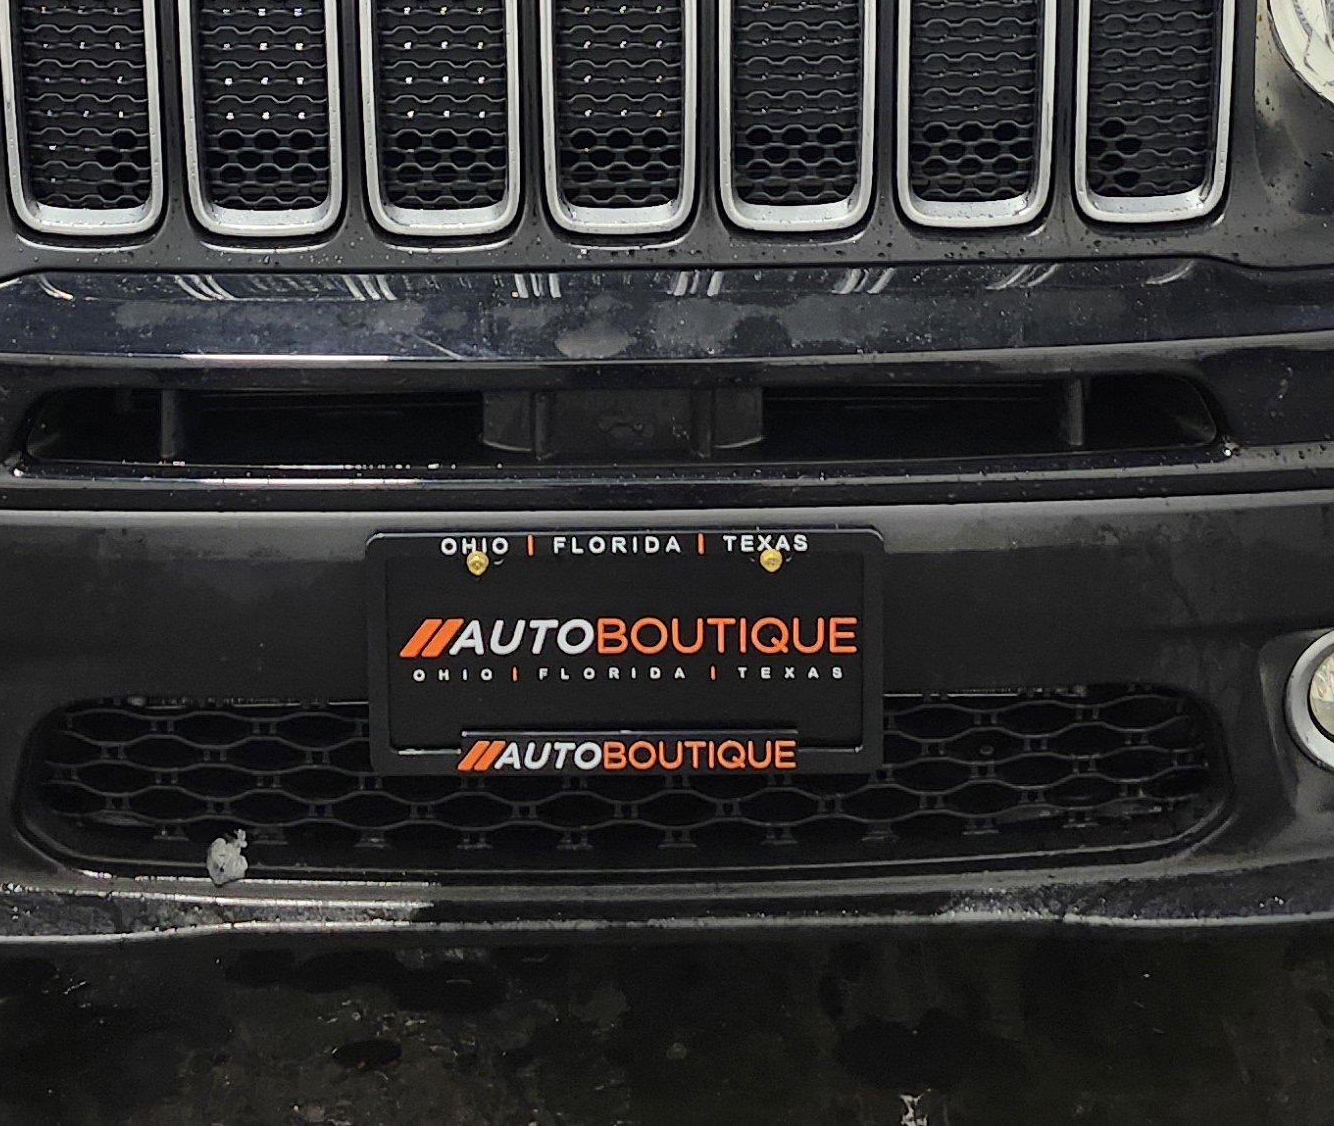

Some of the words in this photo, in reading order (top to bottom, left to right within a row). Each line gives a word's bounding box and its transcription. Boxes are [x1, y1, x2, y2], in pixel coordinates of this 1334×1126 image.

[441, 537, 509, 555] OHIO
[553, 535, 681, 554] FLORIDA
[722, 534, 808, 552] TEXAS
[448, 617, 858, 656] AUTOBOUTIQUE
[412, 669, 493, 682] OHIO
[539, 667, 686, 680] FLORIDA
[737, 666, 843, 679] TEXAS
[493, 740, 797, 770] AUTOBOUTIQUE
